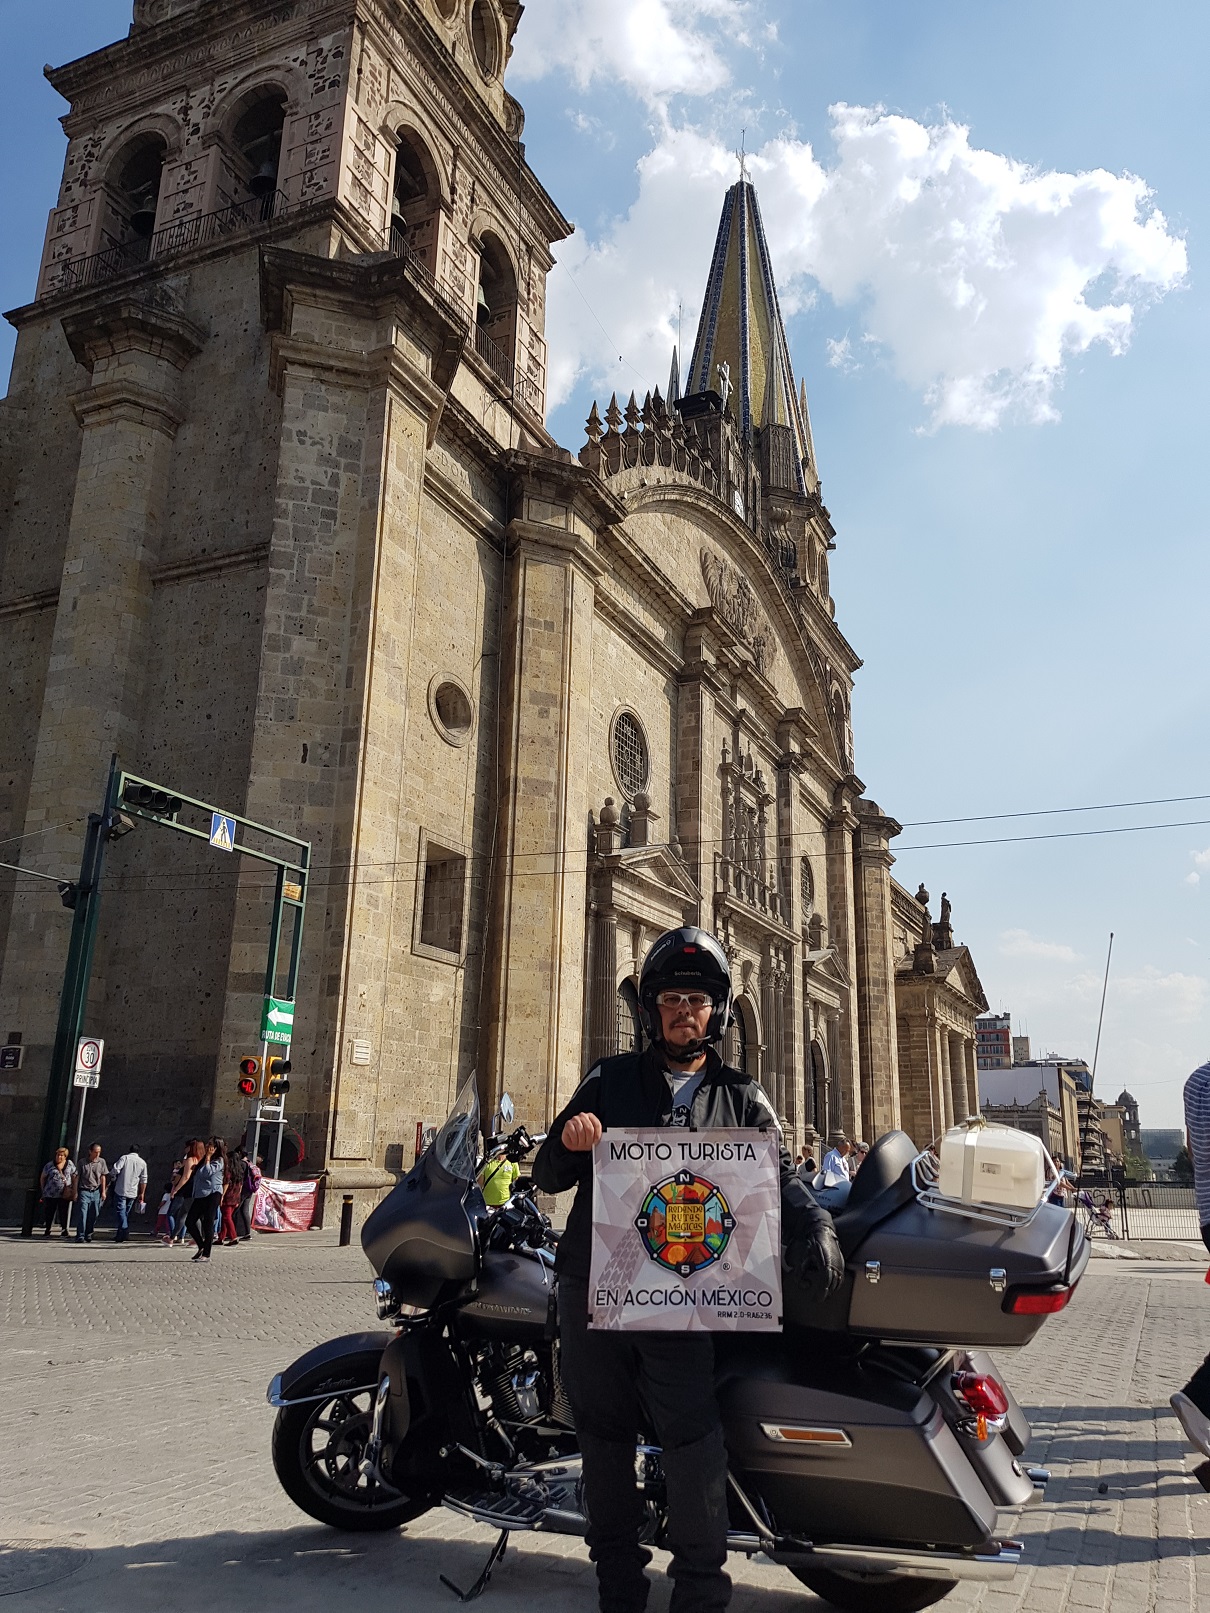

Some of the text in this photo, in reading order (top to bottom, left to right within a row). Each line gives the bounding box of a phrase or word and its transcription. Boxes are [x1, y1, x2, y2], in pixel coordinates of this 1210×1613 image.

[85, 1052, 95, 1064] 30
[610, 1142, 757, 1160] MOTO TURISTA
[679, 1174, 690, 1182] N
[724, 1218, 733, 1227] E
[681, 1265, 690, 1273] S
[595, 1285, 773, 1307] EN ACCIÓN MÉXICO
